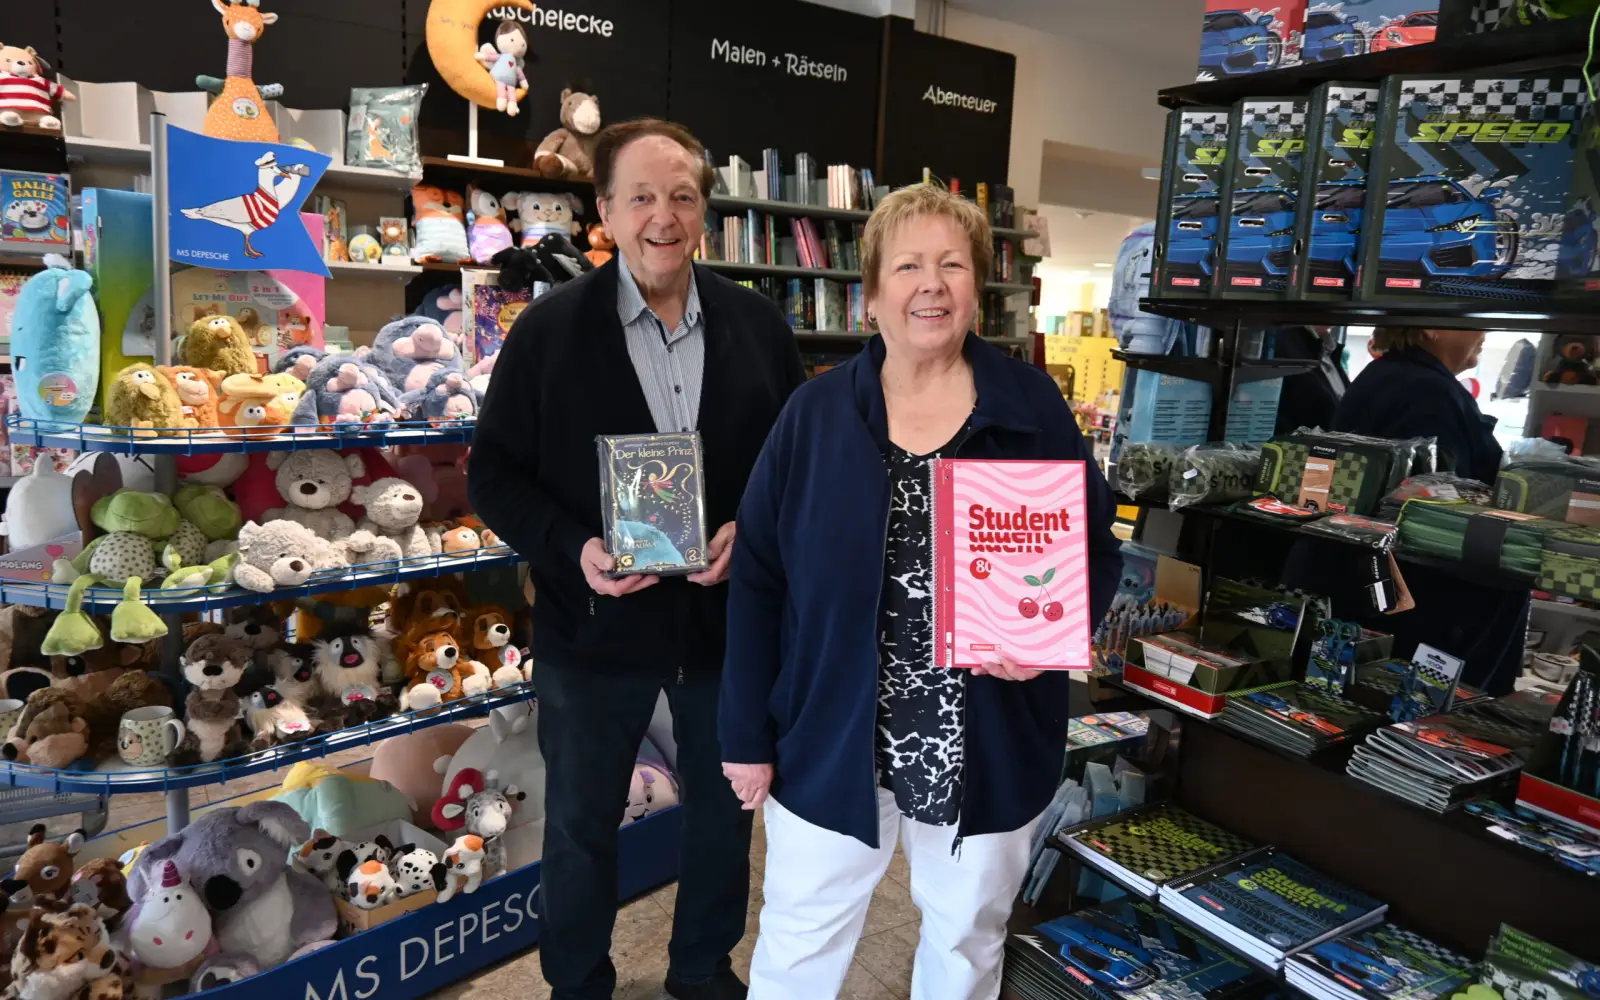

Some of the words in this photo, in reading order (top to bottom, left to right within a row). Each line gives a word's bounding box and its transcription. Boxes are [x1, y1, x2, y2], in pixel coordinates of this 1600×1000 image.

[486, 3, 614, 37] uschelecke
[711, 38, 766, 66] Malen
[784, 52, 848, 82] Rätseln
[922, 85, 997, 113] Abenteuer
[1408, 122, 1572, 143] SPEED
[12, 181, 55, 192] HALLI
[12, 189, 55, 200] GALLI
[176, 249, 190, 257] MS
[191, 250, 230, 261] DEPESCHE
[615, 449, 636, 459] Der
[638, 448, 666, 458] kleine
[667, 446, 693, 457] Prinz
[968, 504, 1070, 531] Student
[0, 561, 43, 570] MOLANG
[1266, 867, 1348, 914] Student
[304, 954, 380, 1000] MS
